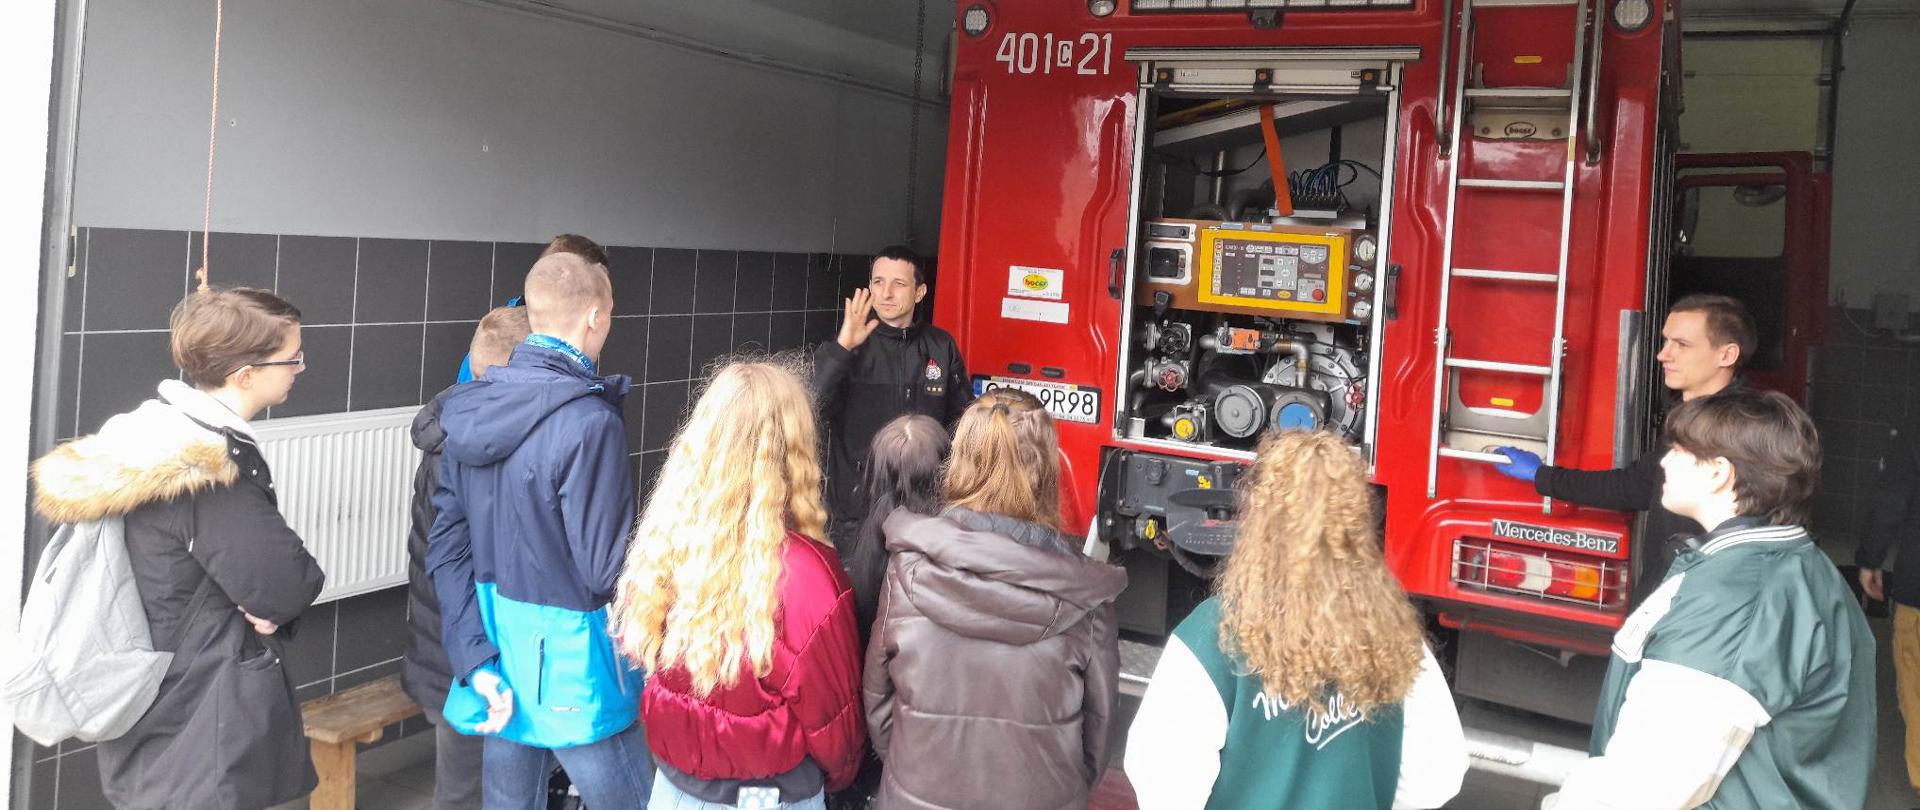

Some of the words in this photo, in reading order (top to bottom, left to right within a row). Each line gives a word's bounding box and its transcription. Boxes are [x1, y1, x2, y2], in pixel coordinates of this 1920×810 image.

[995, 32, 1053, 74] 401
[1077, 32, 1112, 75] 21
[1494, 521, 1617, 553] Mercedes-Benz
